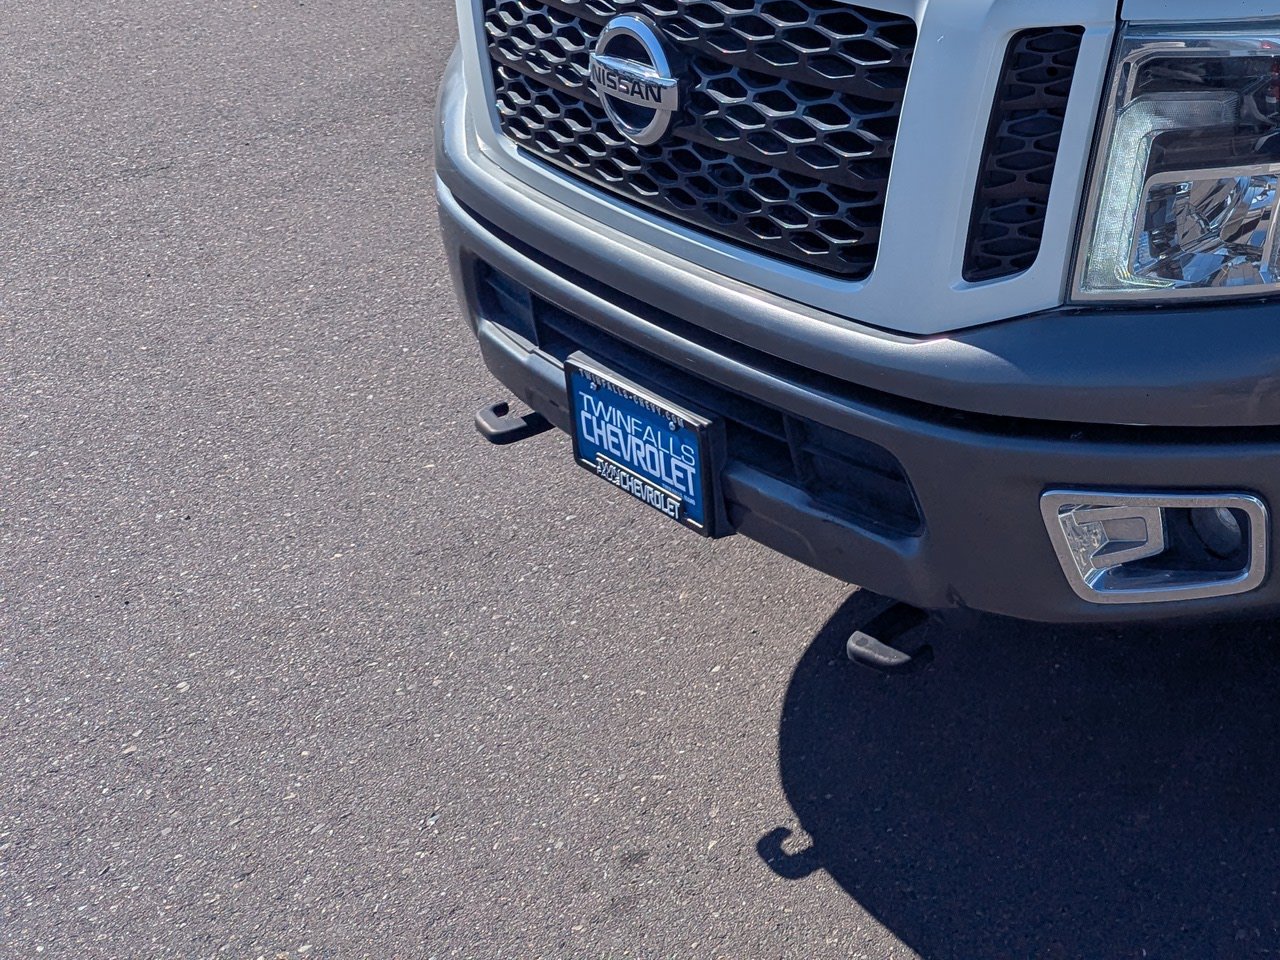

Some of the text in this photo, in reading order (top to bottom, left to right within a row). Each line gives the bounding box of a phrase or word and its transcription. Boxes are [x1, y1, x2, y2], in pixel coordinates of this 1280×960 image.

[591, 63, 665, 104] NISSAN
[580, 410, 697, 497] CHEVROLET
[619, 473, 681, 520] CHEVROLET
